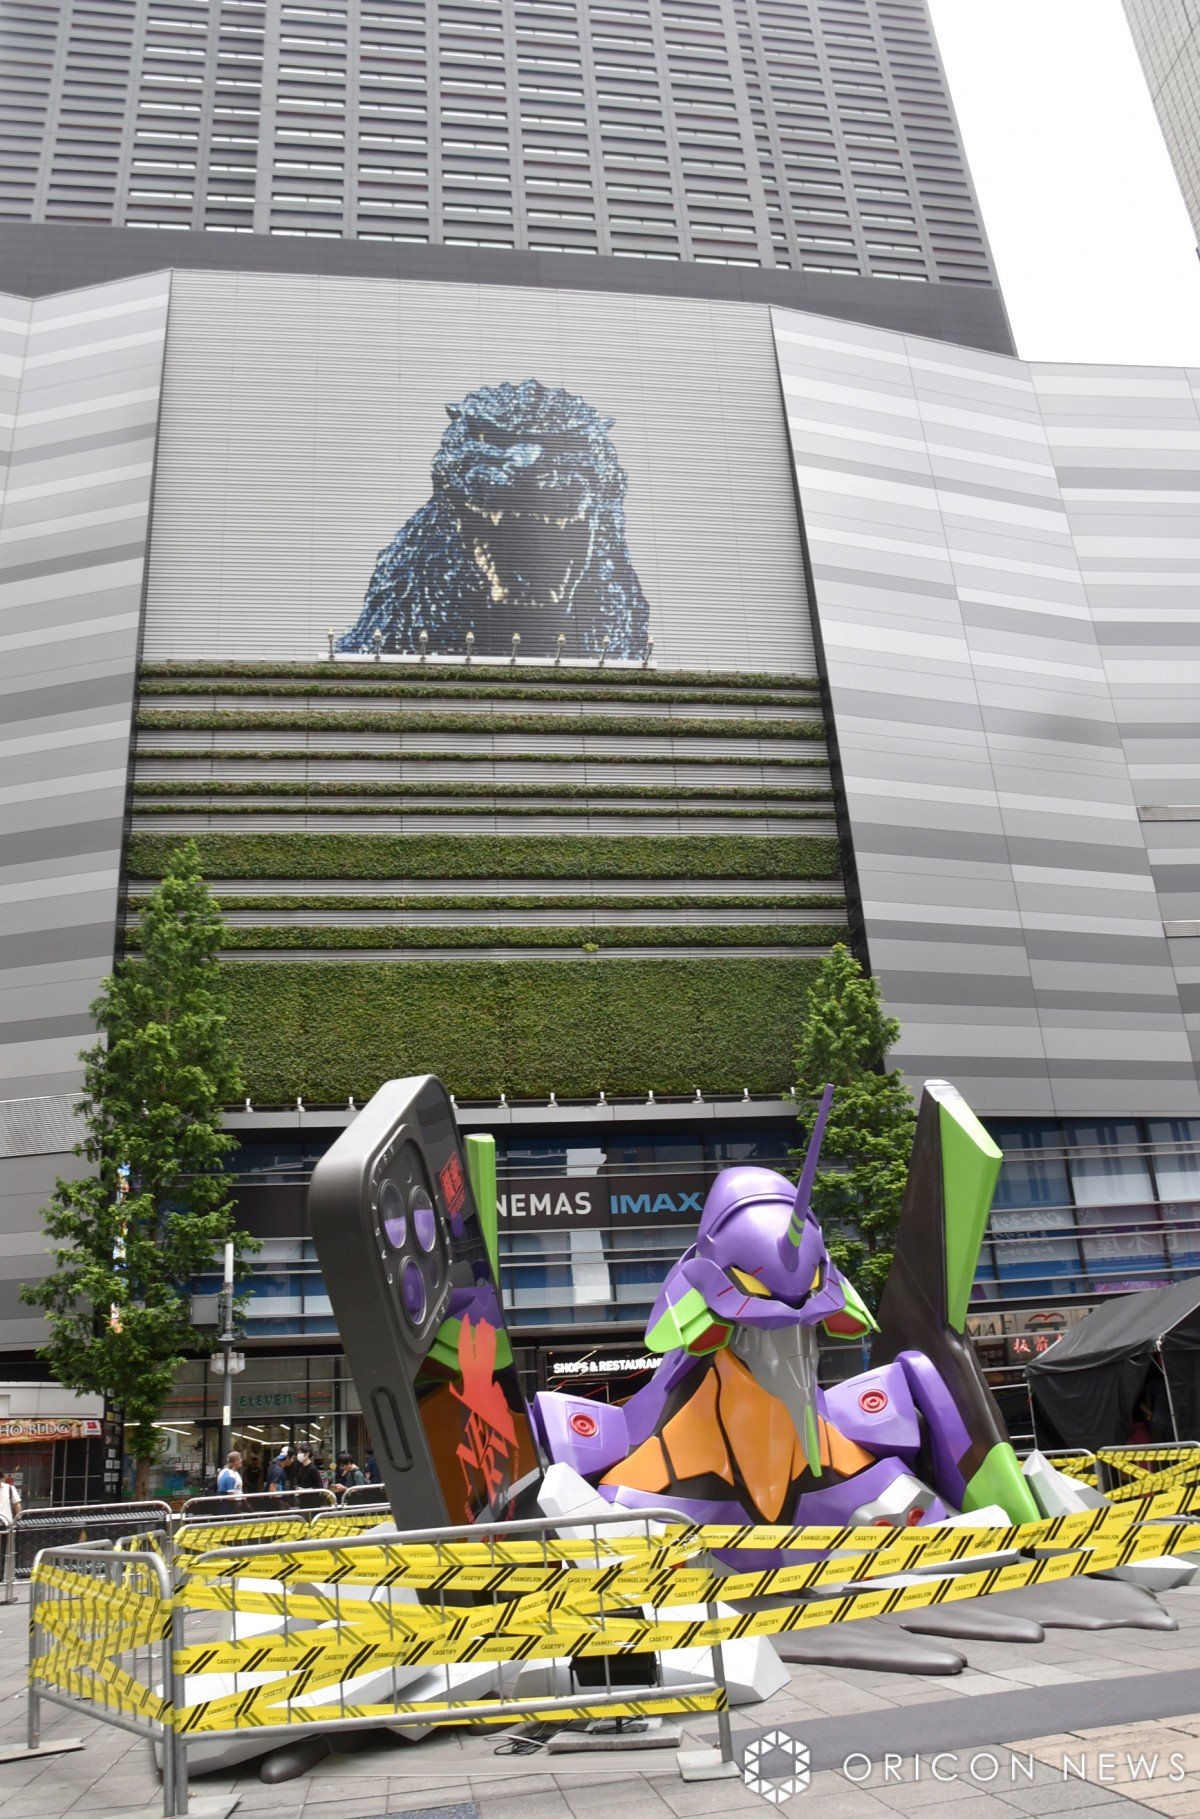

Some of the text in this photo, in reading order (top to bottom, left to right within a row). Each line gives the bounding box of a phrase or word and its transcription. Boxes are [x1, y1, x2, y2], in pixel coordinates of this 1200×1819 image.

[610, 1192, 703, 1214] IMAX
[1013, 1334, 1062, 1353] 板前
[553, 1358, 663, 1374] SHOPS & RESTAURAN
[29, 1422, 70, 1436] BLDG
[724, 1582, 754, 1592] EVANGELION
[778, 1575, 801, 1583] CASETIFY
[826, 1566, 855, 1576] EVANGELION
[878, 1557, 900, 1566] CASETIFY
[470, 1617, 493, 1629] CASETIFY
[518, 1599, 549, 1612] EVANGELION
[756, 1618, 779, 1627] CASETIFY
[803, 1609, 833, 1620] EVANGELION
[857, 1602, 879, 1610] CASETIFY
[903, 1592, 932, 1601] EVANGELION
